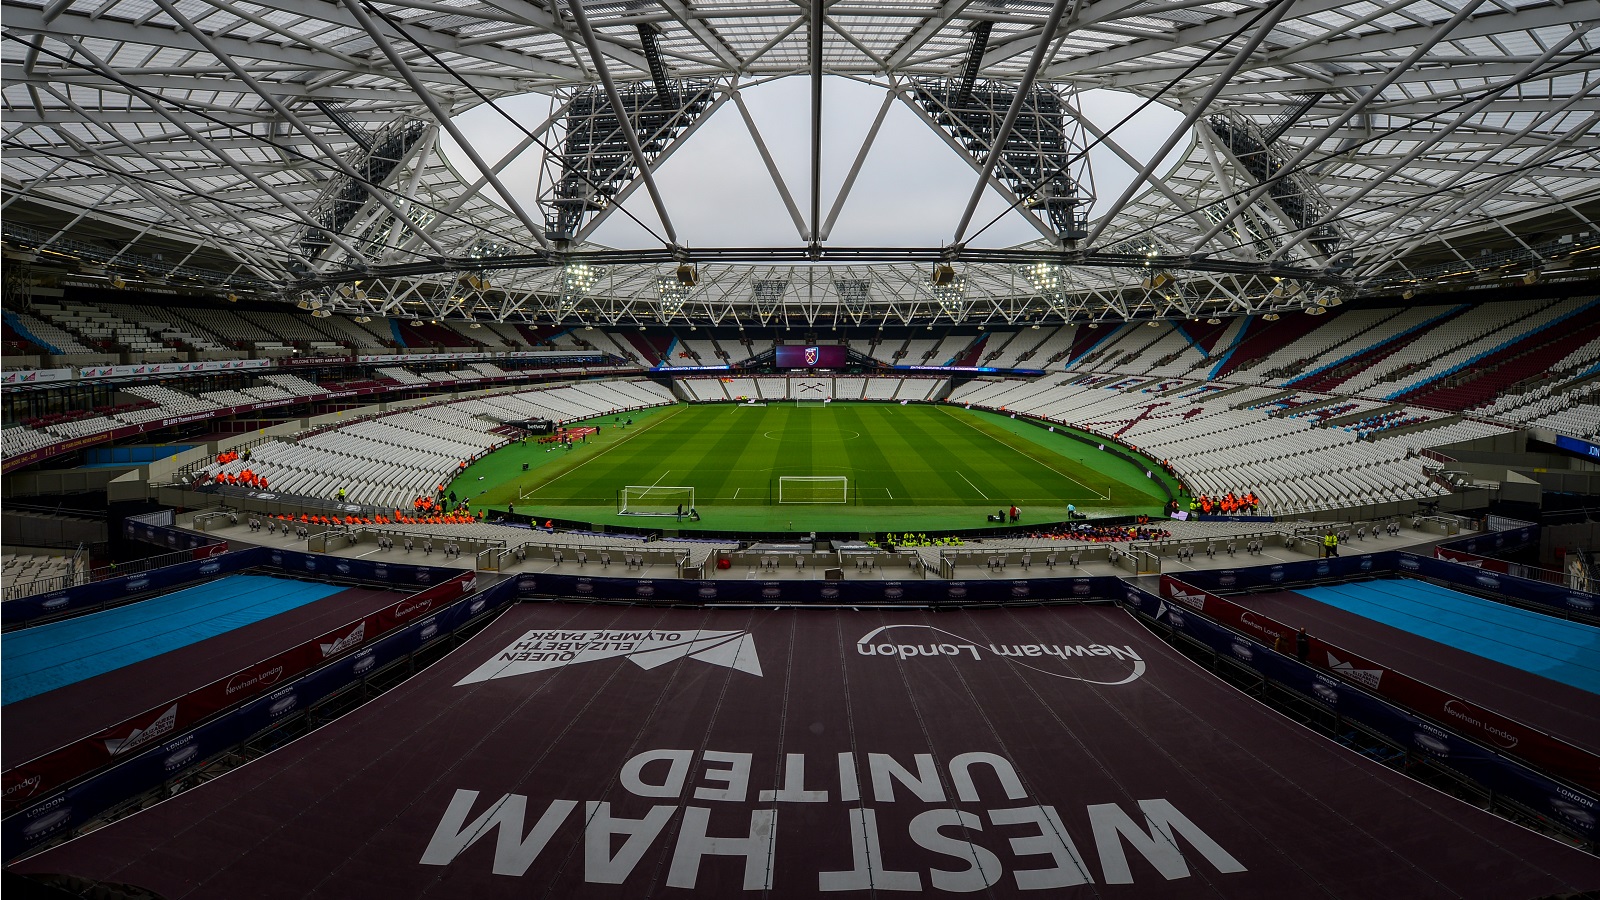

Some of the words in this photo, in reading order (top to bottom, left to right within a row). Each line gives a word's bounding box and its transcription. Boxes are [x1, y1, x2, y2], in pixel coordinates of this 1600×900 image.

[126, 572, 148, 580] LONDON
[43, 590, 67, 598] LONDON
[1569, 590, 1593, 598] LONDON
[1241, 617, 1263, 631] Newham
[528, 632, 591, 641] PARK
[593, 632, 682, 642] OLYMPIC
[1234, 635, 1253, 646] LONDON
[352, 648, 372, 659] LONDON
[513, 642, 634, 651] ELIZABETH
[856, 643, 982, 661] London
[989, 643, 1143, 661] Newham
[498, 651, 576, 662] QUEEN
[226, 678, 258, 695] Newham
[258, 666, 283, 681] London
[1315, 673, 1338, 687] LONDON
[269, 686, 293, 700] LONDON
[155, 714, 175, 727] QUEEN
[1444, 705, 1481, 728] Newham
[1483, 722, 1519, 744] London
[142, 720, 174, 738] ELIZABETH
[1418, 723, 1449, 740] LONDON
[130, 733, 156, 747] OLYMPIC
[165, 734, 194, 752] LONDON
[619, 749, 1029, 803] UNITED
[1, 774, 41, 798] London
[1556, 786, 1594, 807] LONDON
[26, 796, 65, 818] LONDON
[418, 788, 778, 891] HAM
[818, 798, 1248, 892] WEST
